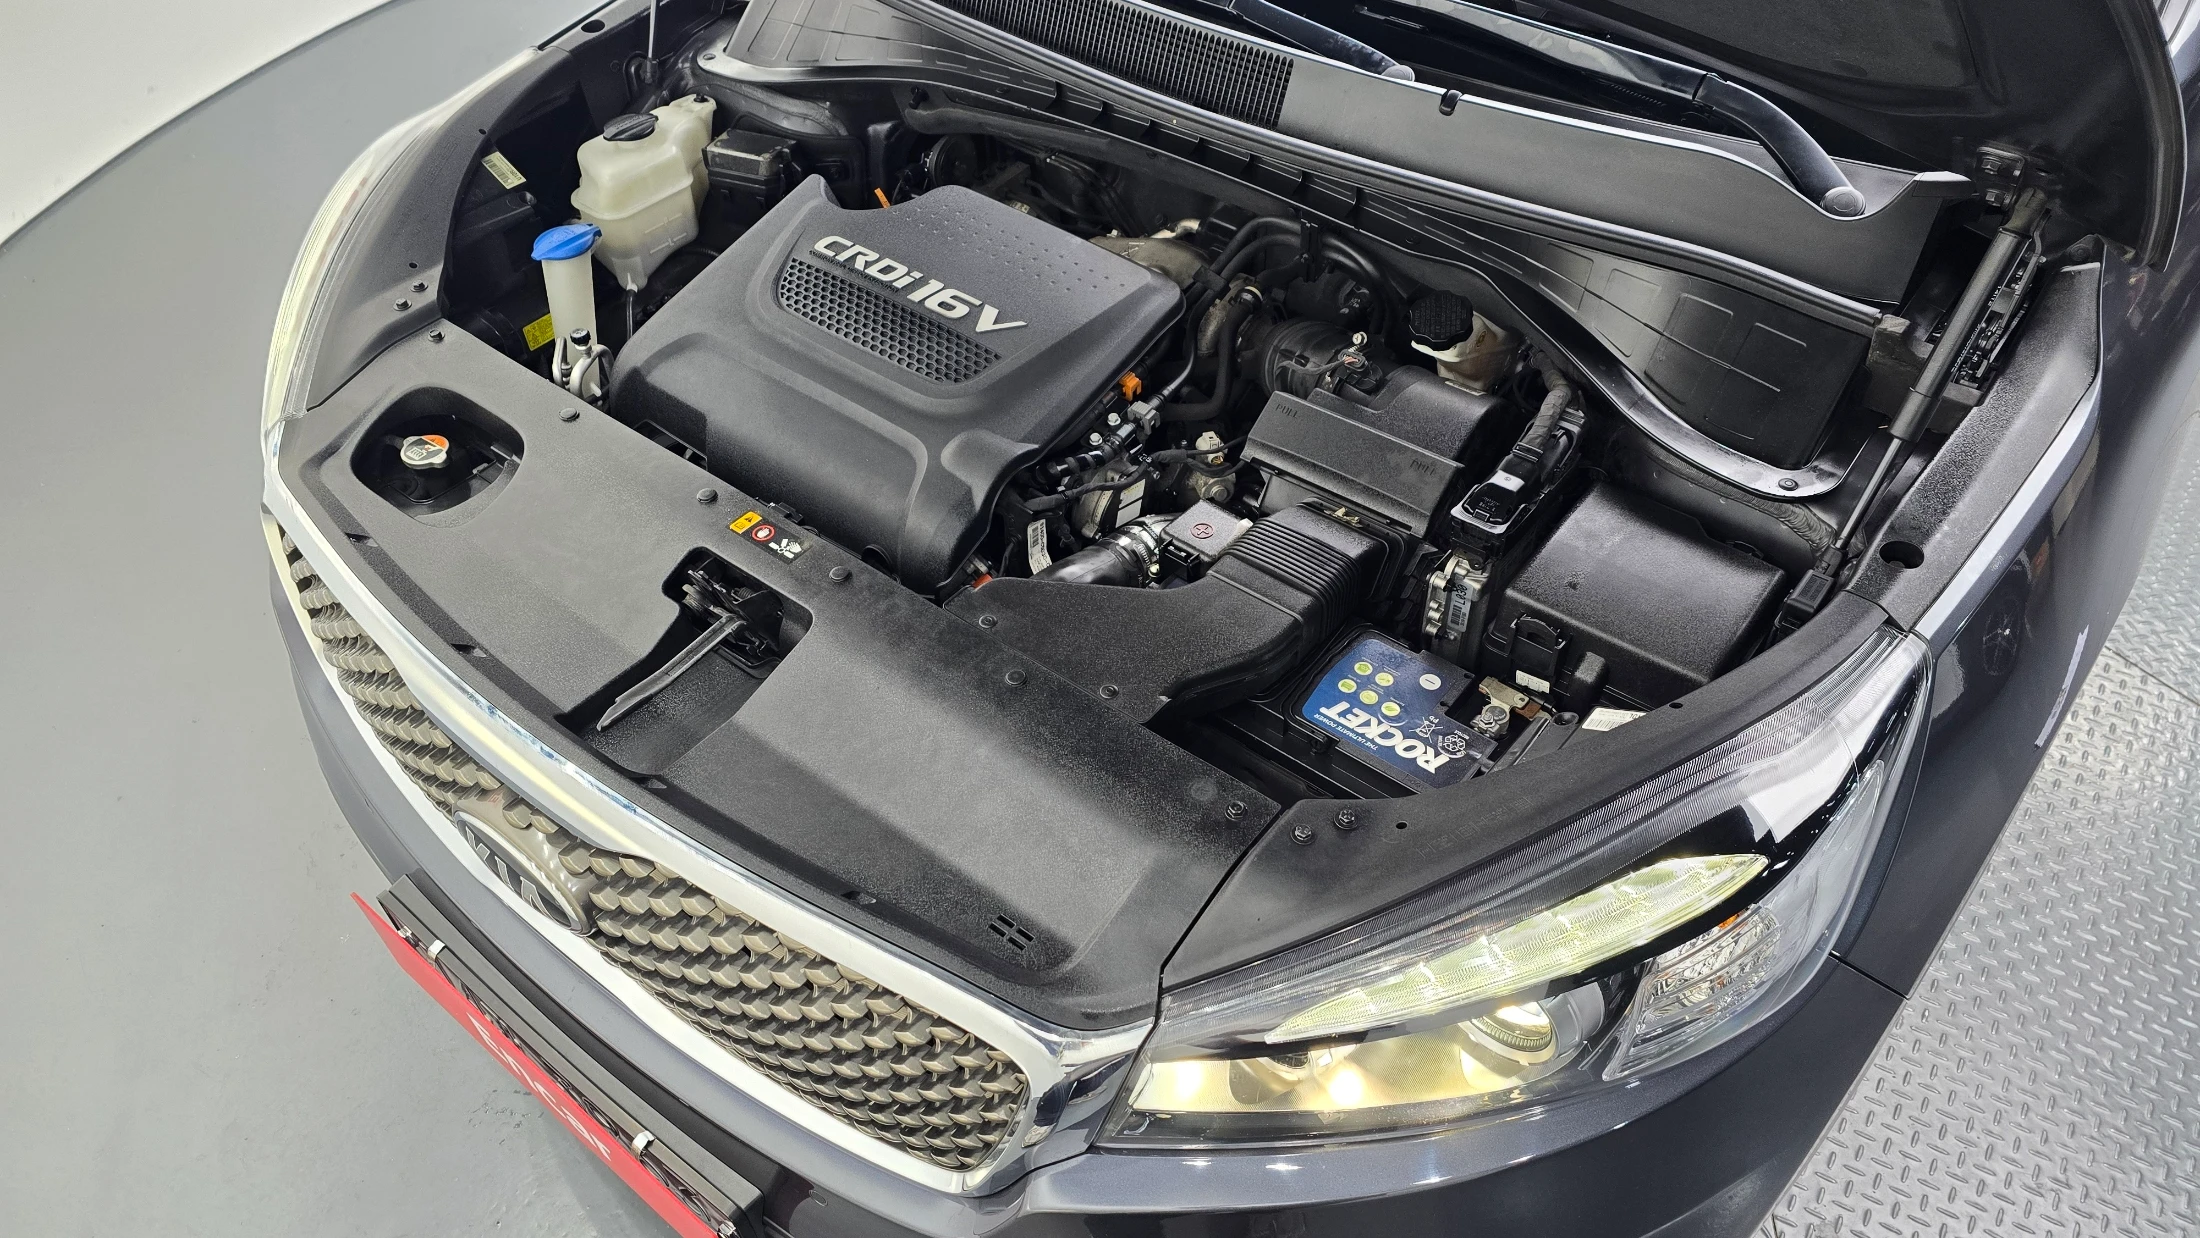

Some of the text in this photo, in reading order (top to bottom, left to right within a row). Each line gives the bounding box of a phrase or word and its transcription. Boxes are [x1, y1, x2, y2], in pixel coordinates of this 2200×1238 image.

[814, 235, 924, 289] CRDi
[907, 278, 1028, 333] 16V
[1275, 403, 1299, 419] PULL
[1313, 713, 1379, 751] THE ULTIMATE POWER
[1319, 700, 1450, 774] ROCKET
[1429, 715, 1440, 724] Pb
